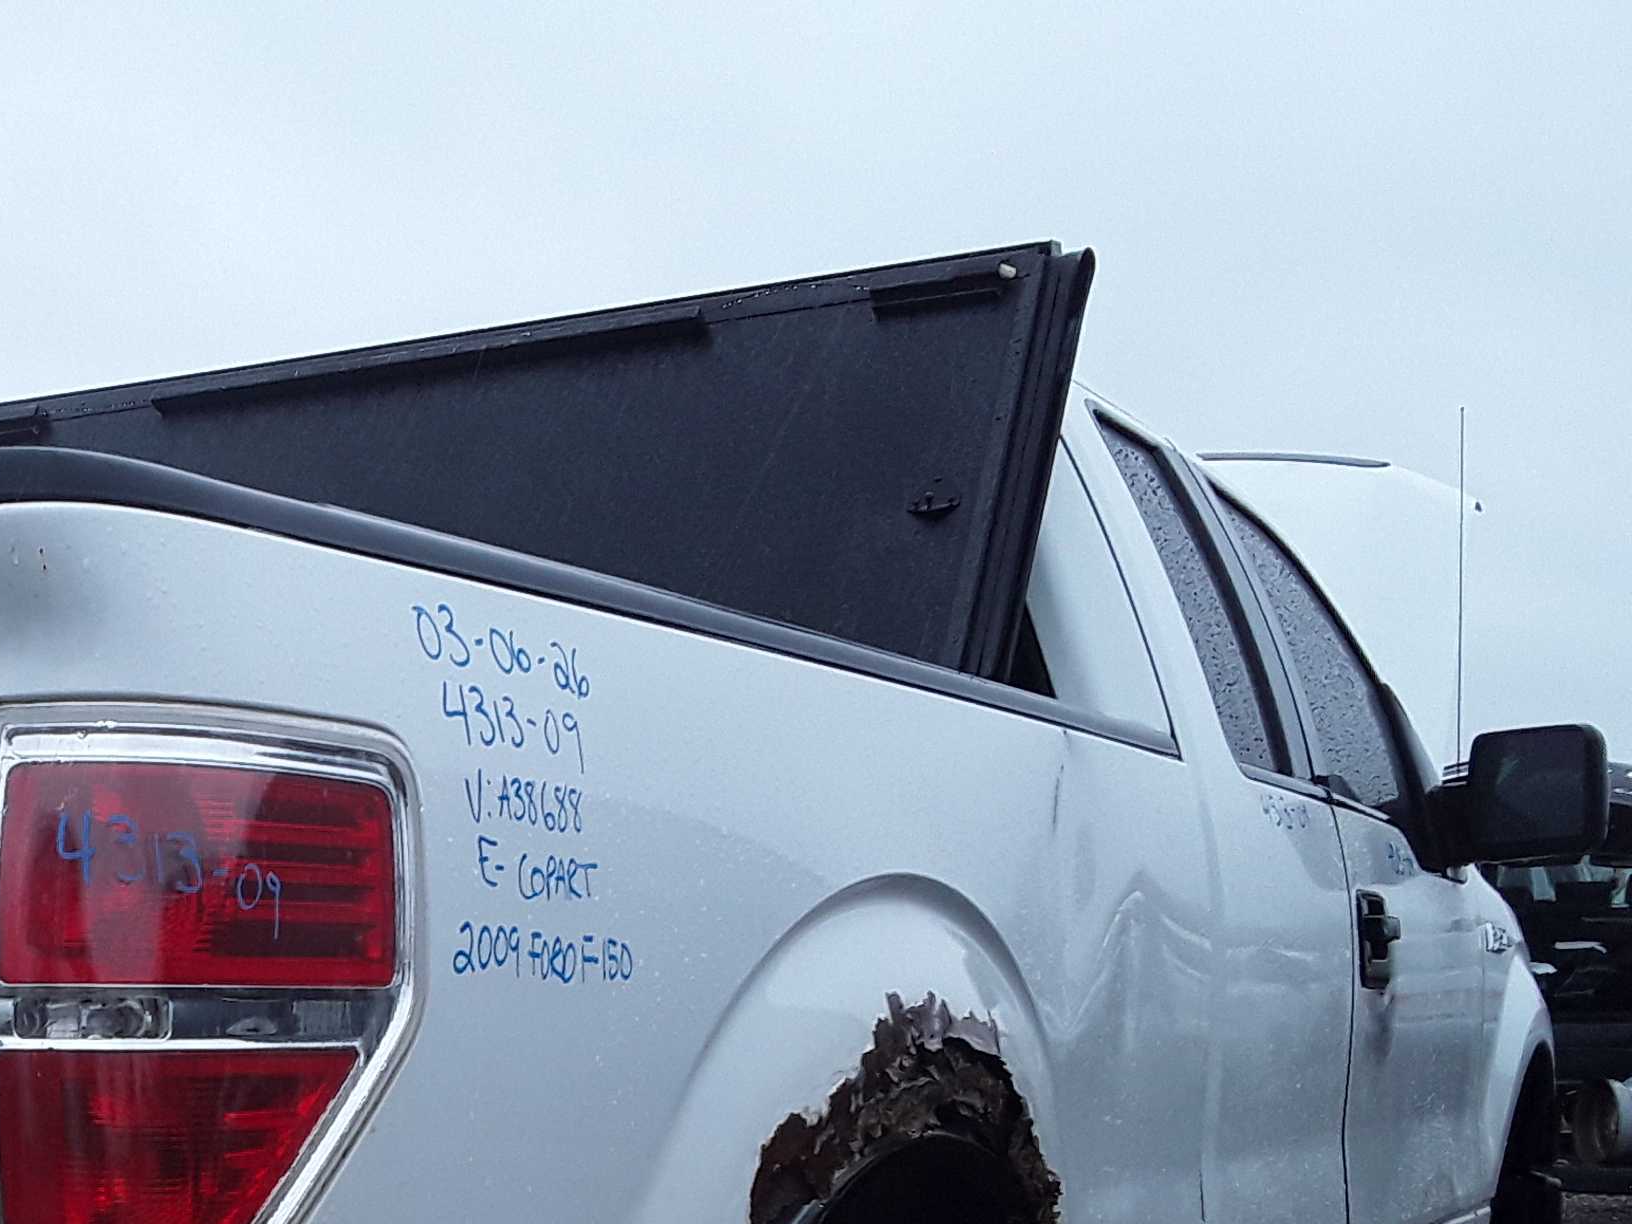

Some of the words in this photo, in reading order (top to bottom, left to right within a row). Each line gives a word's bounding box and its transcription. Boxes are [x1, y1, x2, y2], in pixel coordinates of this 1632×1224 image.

[412, 602, 590, 700] 03-06-26
[443, 680, 585, 774] 4313-09
[56, 806, 282, 940] 4313-09
[453, 920, 520, 979] 2009
